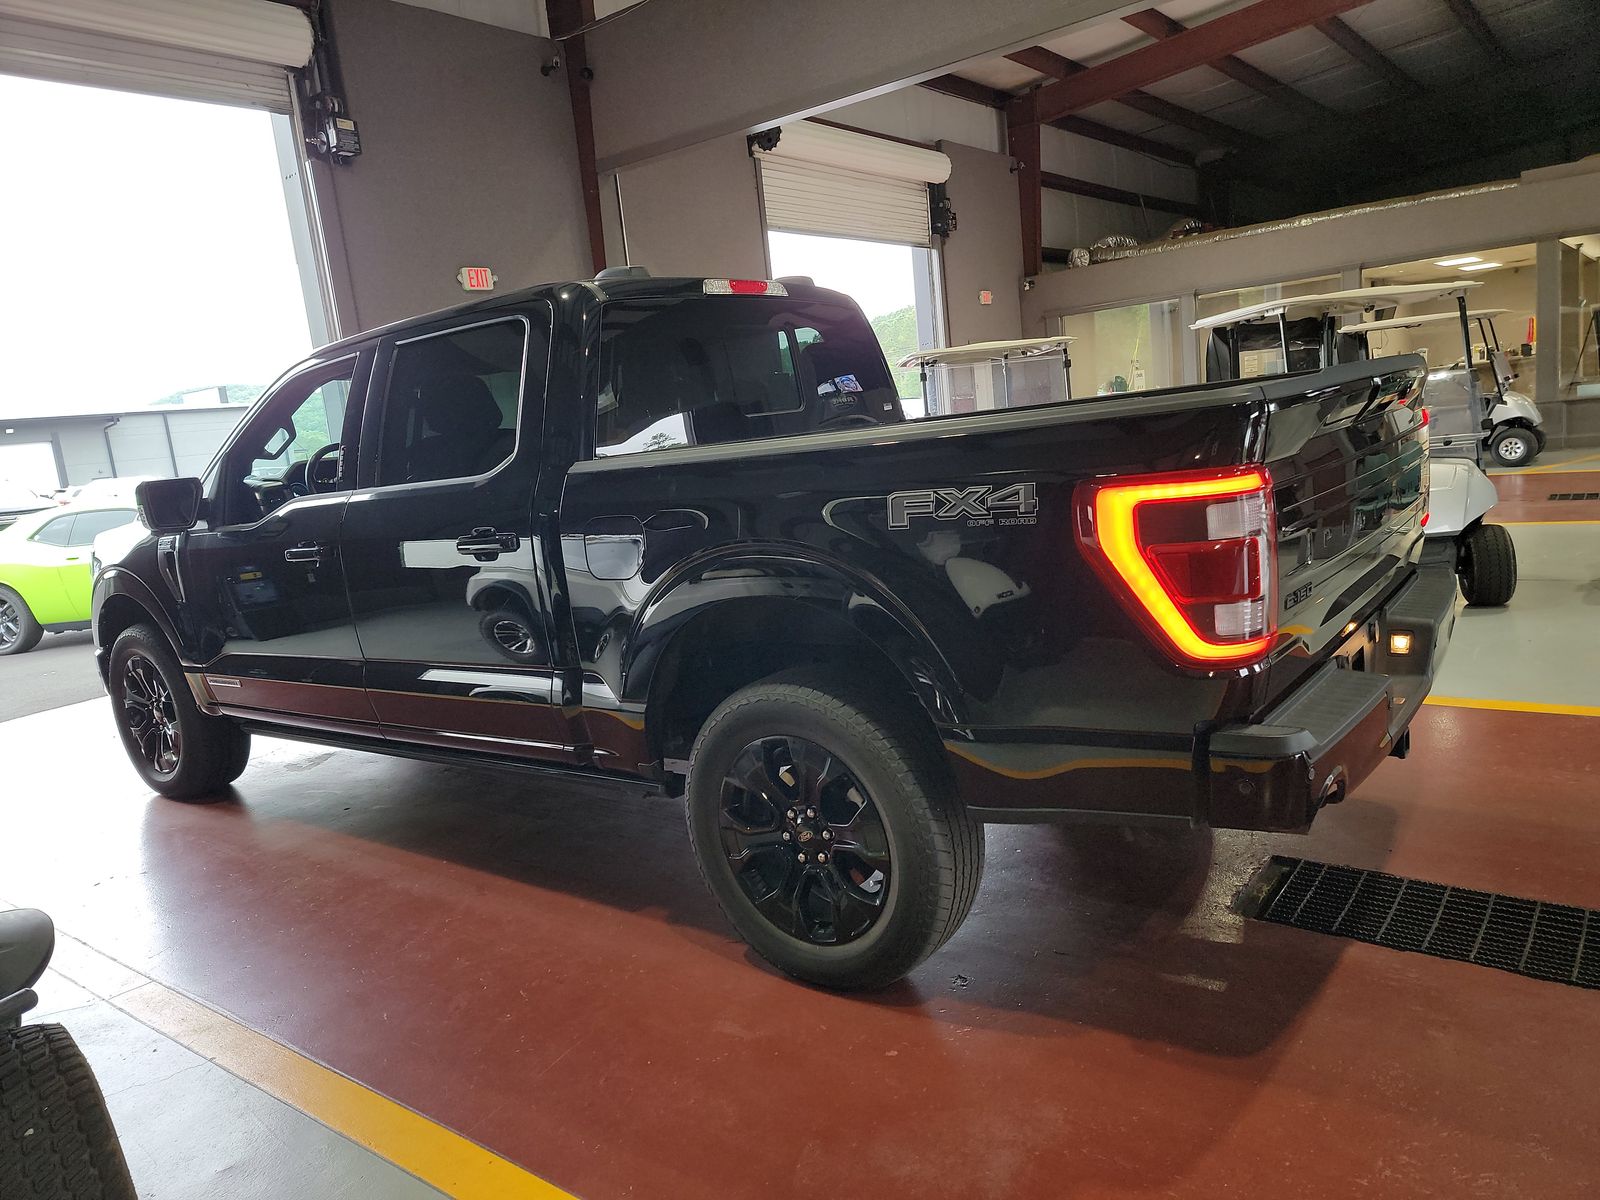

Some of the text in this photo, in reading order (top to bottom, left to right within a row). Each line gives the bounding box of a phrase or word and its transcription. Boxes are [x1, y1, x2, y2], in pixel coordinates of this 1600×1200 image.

[468, 269, 489, 288] EXIT
[887, 482, 1038, 530] FX4
[967, 517, 1037, 527] OFF ROAD
